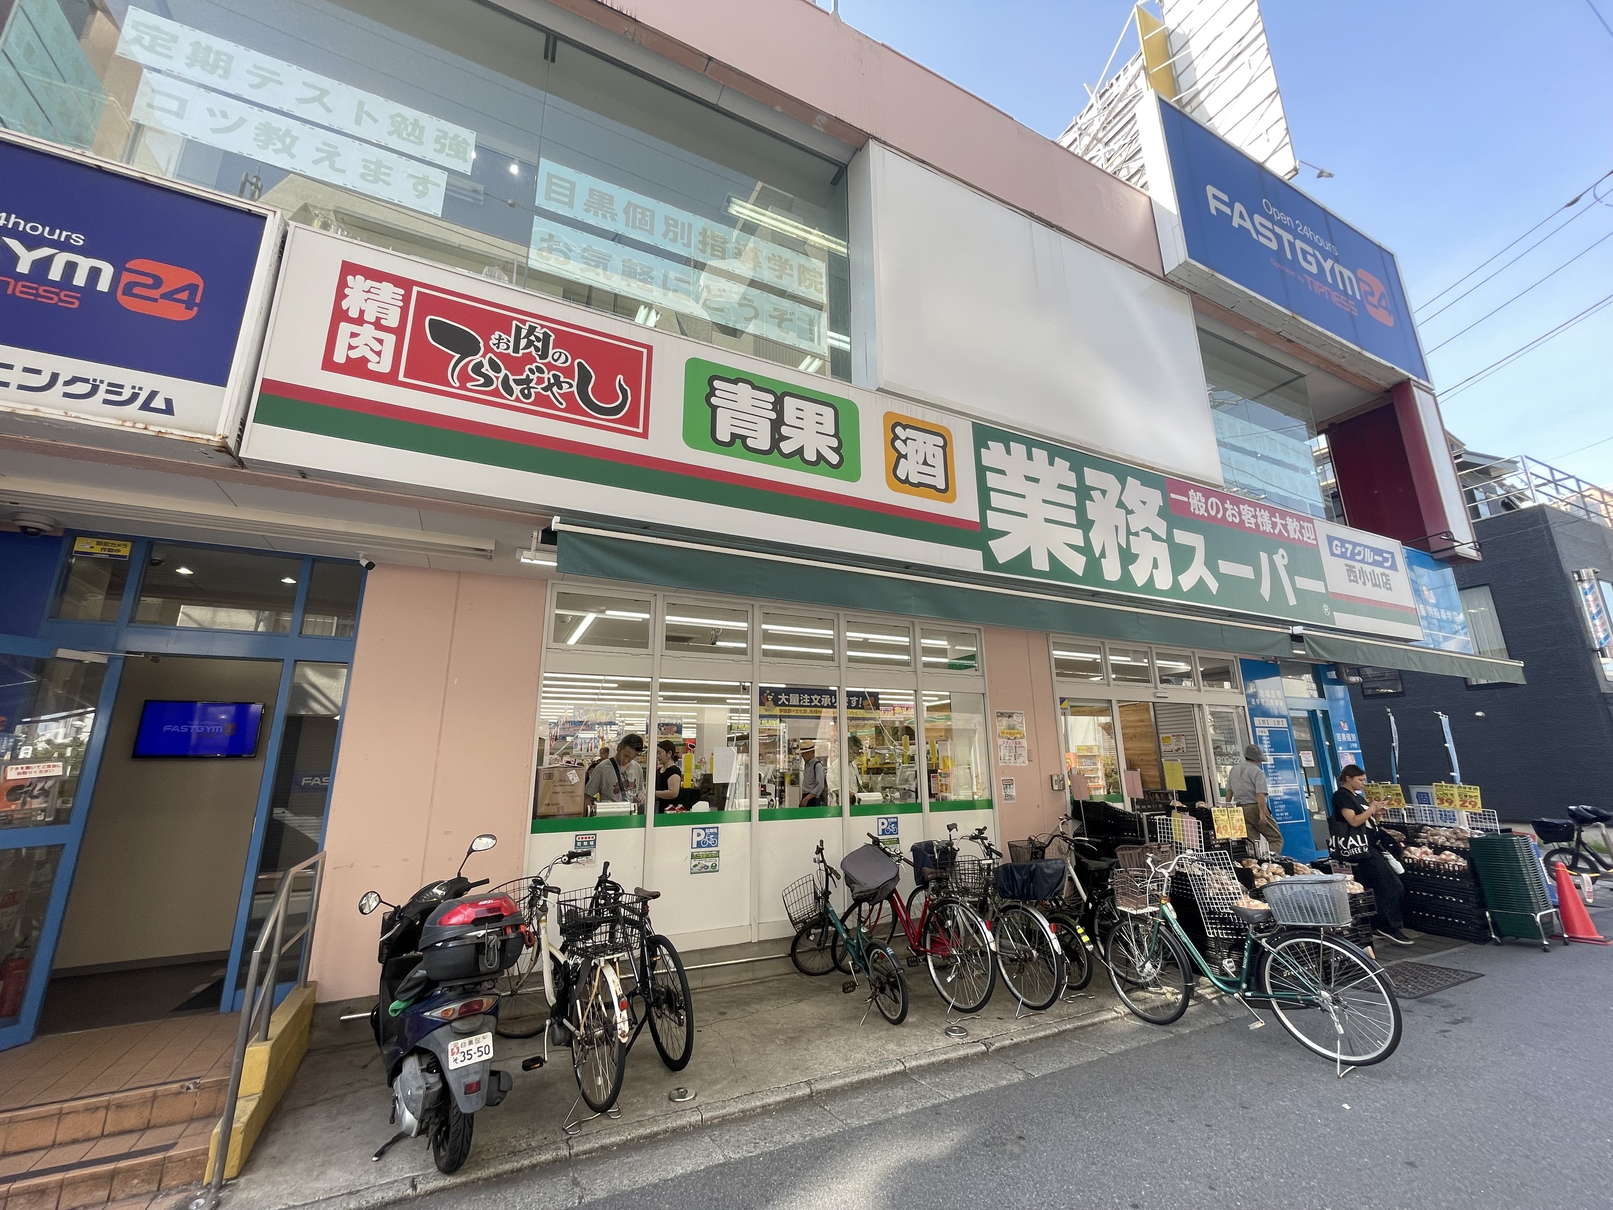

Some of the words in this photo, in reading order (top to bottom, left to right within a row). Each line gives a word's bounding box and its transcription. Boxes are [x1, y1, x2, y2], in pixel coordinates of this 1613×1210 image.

[124, 21, 473, 163] 定期テスト勉強
[143, 87, 442, 201] コツ教えます
[1262, 198, 1294, 226] Open
[119, 264, 203, 315] 24
[332, 274, 405, 374] 精肉
[489, 321, 570, 366] お肉の
[706, 375, 844, 468] 青果
[892, 422, 949, 494] 酒
[980, 440, 1326, 607] 業務スーパー
[1169, 488, 1317, 546] 一般のお客様大歓迎
[1344, 563, 1393, 592] 西小山店
[692, 828, 706, 847] P
[879, 818, 888, 834] P
[460, 1044, 491, 1062] 35-50
